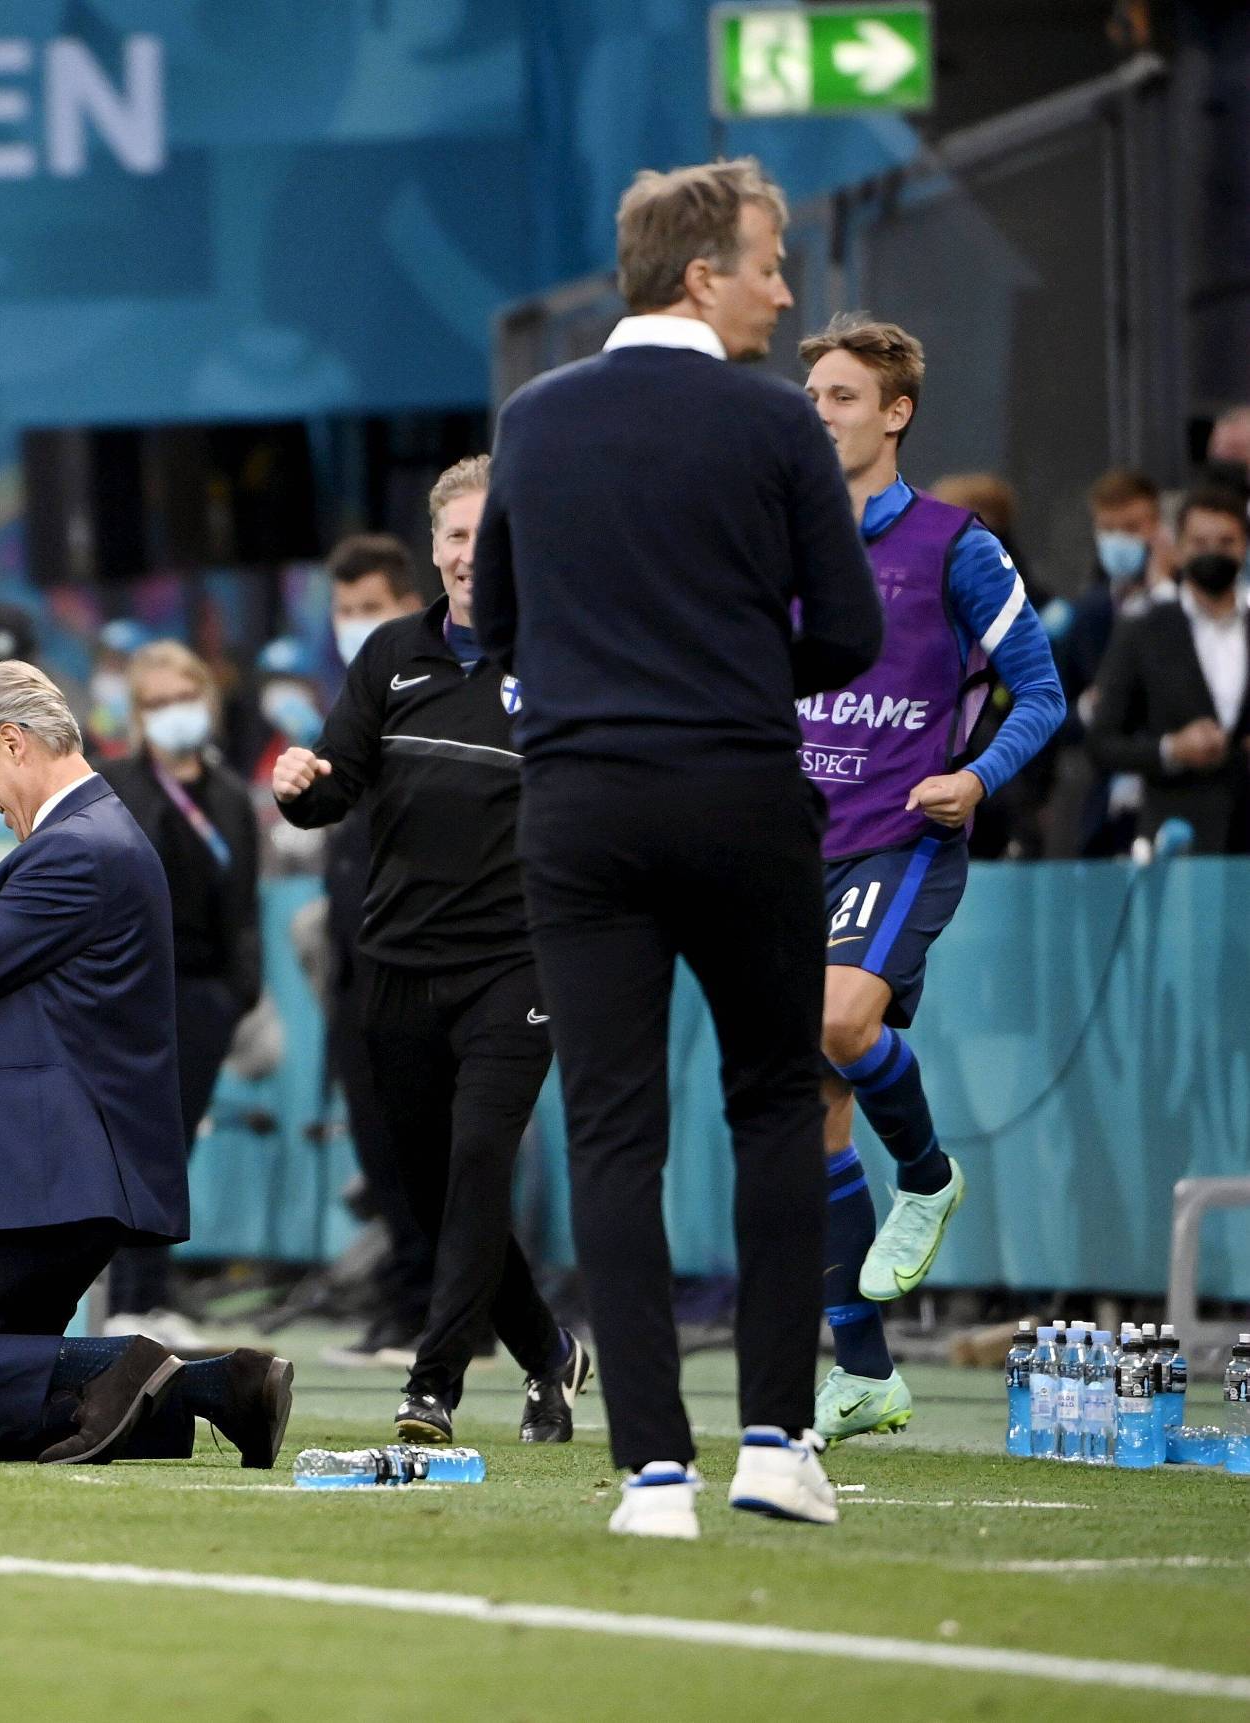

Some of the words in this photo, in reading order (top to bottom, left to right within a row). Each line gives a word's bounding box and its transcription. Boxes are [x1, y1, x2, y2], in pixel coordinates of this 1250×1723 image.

[831, 691, 930, 729] GAME
[796, 750, 868, 776] SPECT
[828, 881, 881, 935] 21
